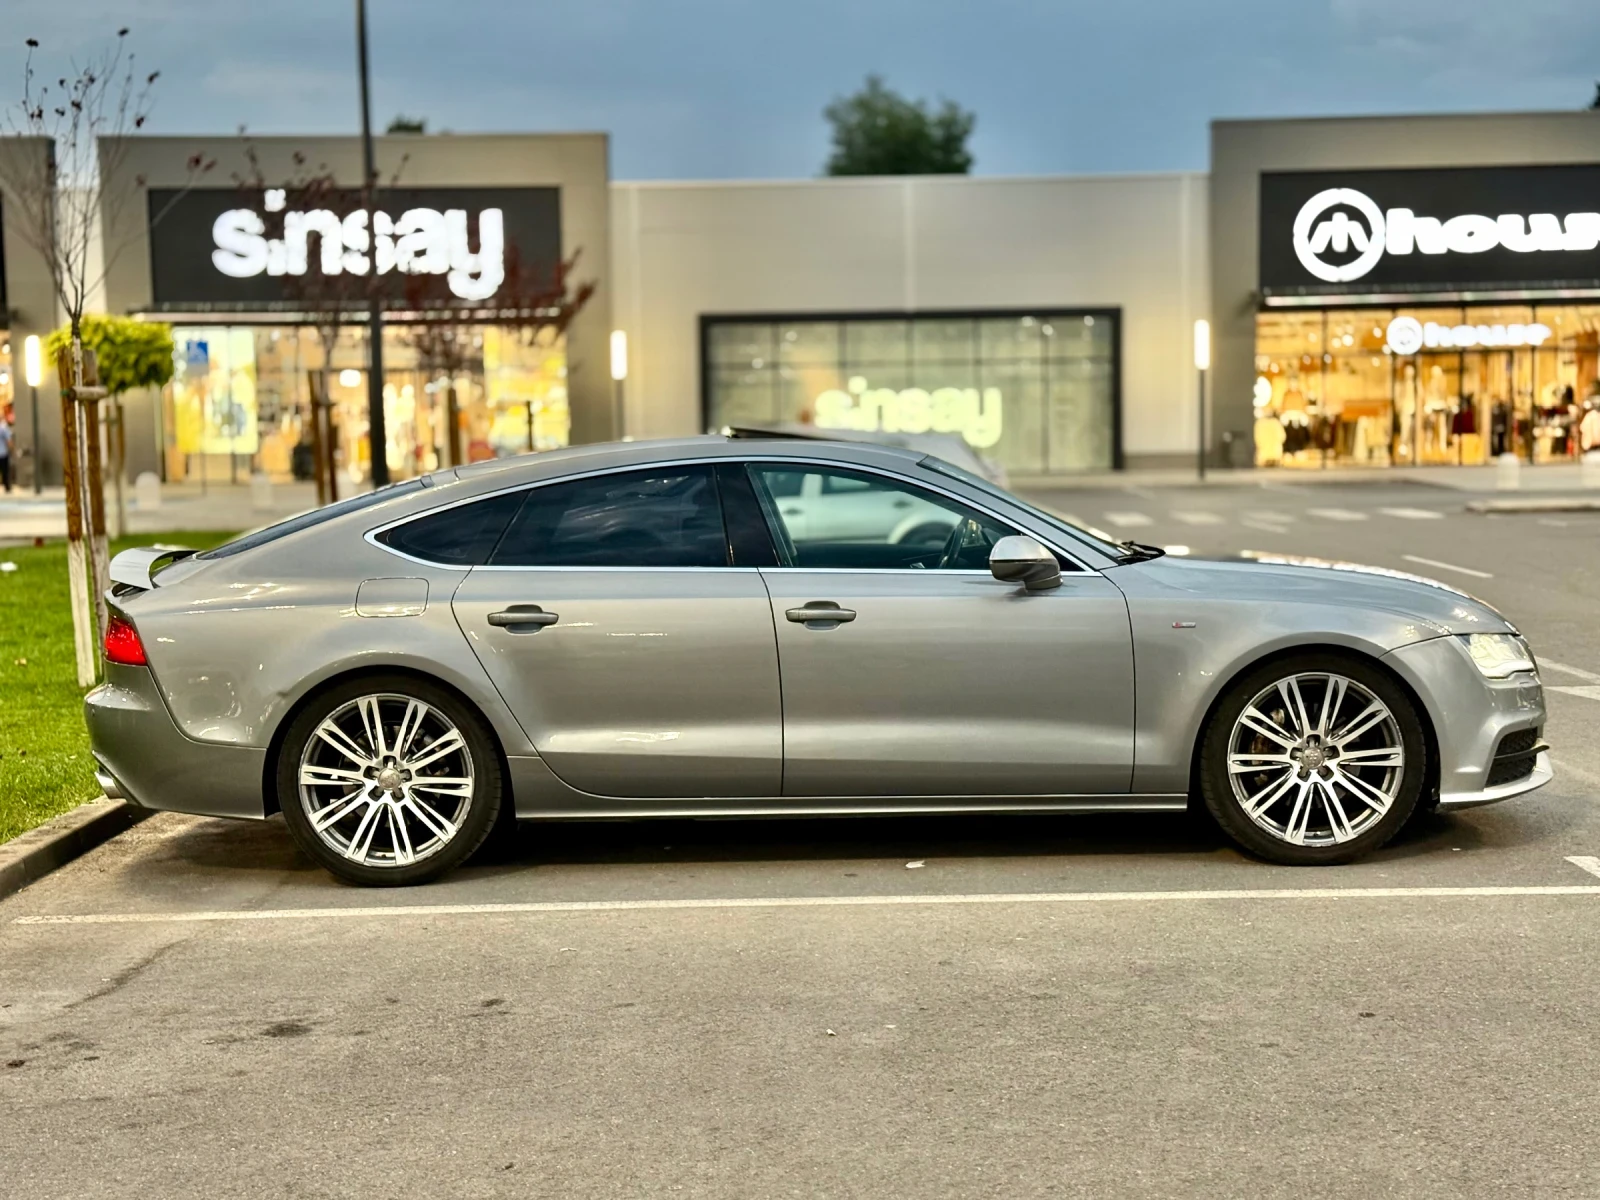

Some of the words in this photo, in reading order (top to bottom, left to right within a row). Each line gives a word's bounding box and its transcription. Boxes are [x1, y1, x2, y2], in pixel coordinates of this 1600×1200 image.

[212, 189, 504, 300] sinsay
[1386, 208, 1600, 254] hous
[814, 376, 1002, 448] sinsay
